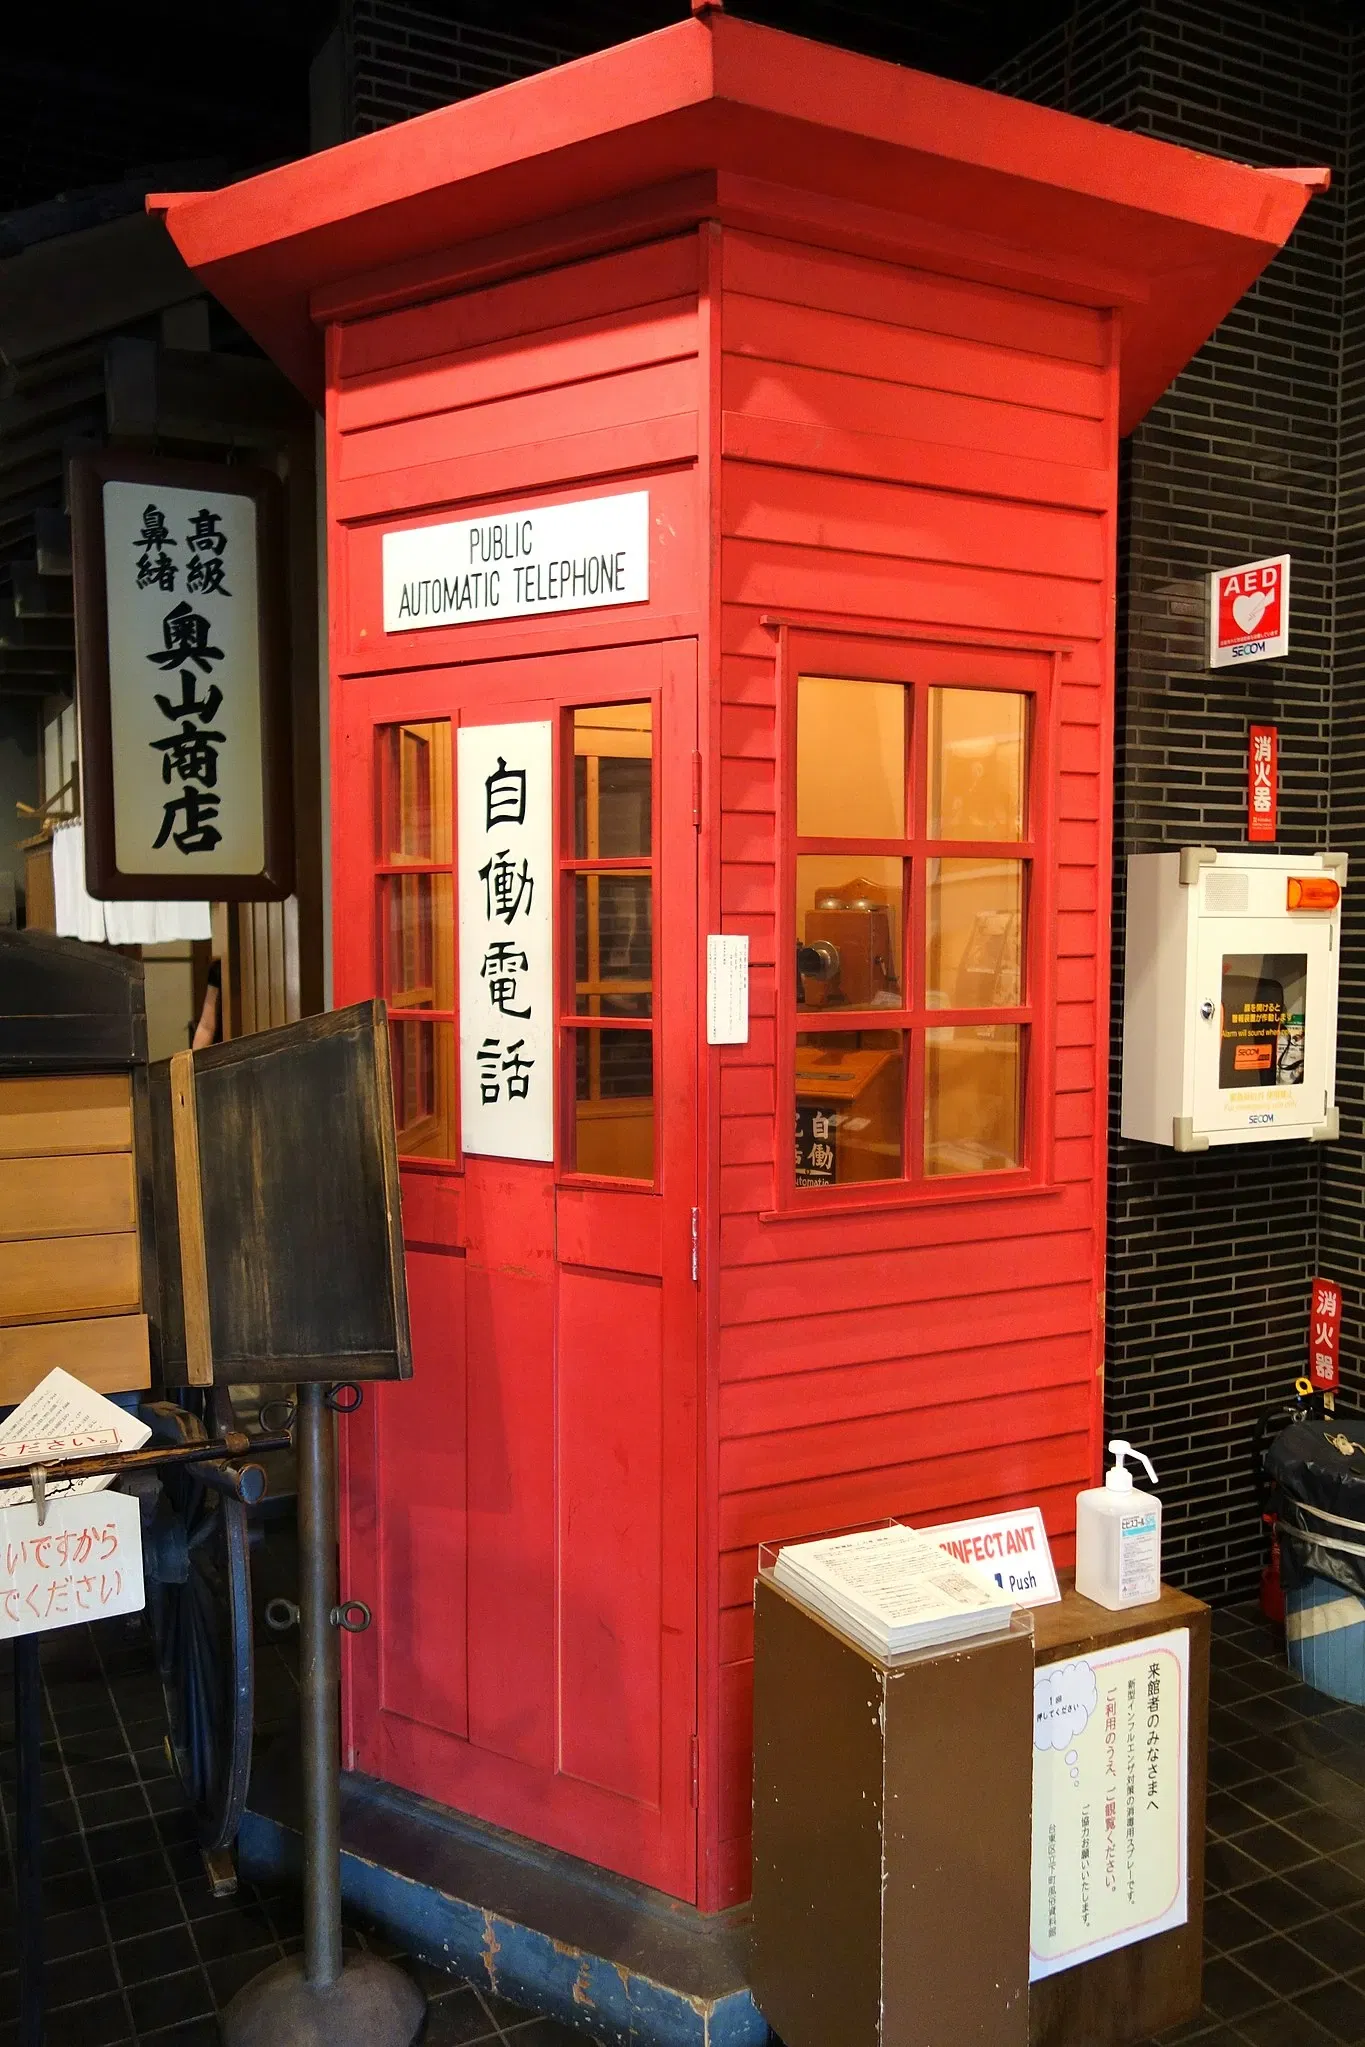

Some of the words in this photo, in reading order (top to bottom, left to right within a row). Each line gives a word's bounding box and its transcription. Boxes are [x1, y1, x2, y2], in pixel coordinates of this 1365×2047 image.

[469, 519, 533, 565] PUBLIC
[398, 570, 501, 619] AUTOMATIC
[513, 551, 627, 604] TELEPHONE
[1223, 566, 1278, 597] AED
[1231, 641, 1266, 658] SECOM
[145, 600, 227, 856] 奥山商店
[1253, 735, 1272, 813] 消火器
[476, 756, 536, 1106] 自働電話
[1248, 1114, 1274, 1125] SECOM
[1314, 1289, 1338, 1381] 消火器
[0, 1523, 118, 1576] いですから
[1009, 1570, 1037, 1593] Push
[1146, 1662, 1161, 1811] 来館者のみなさまへ
